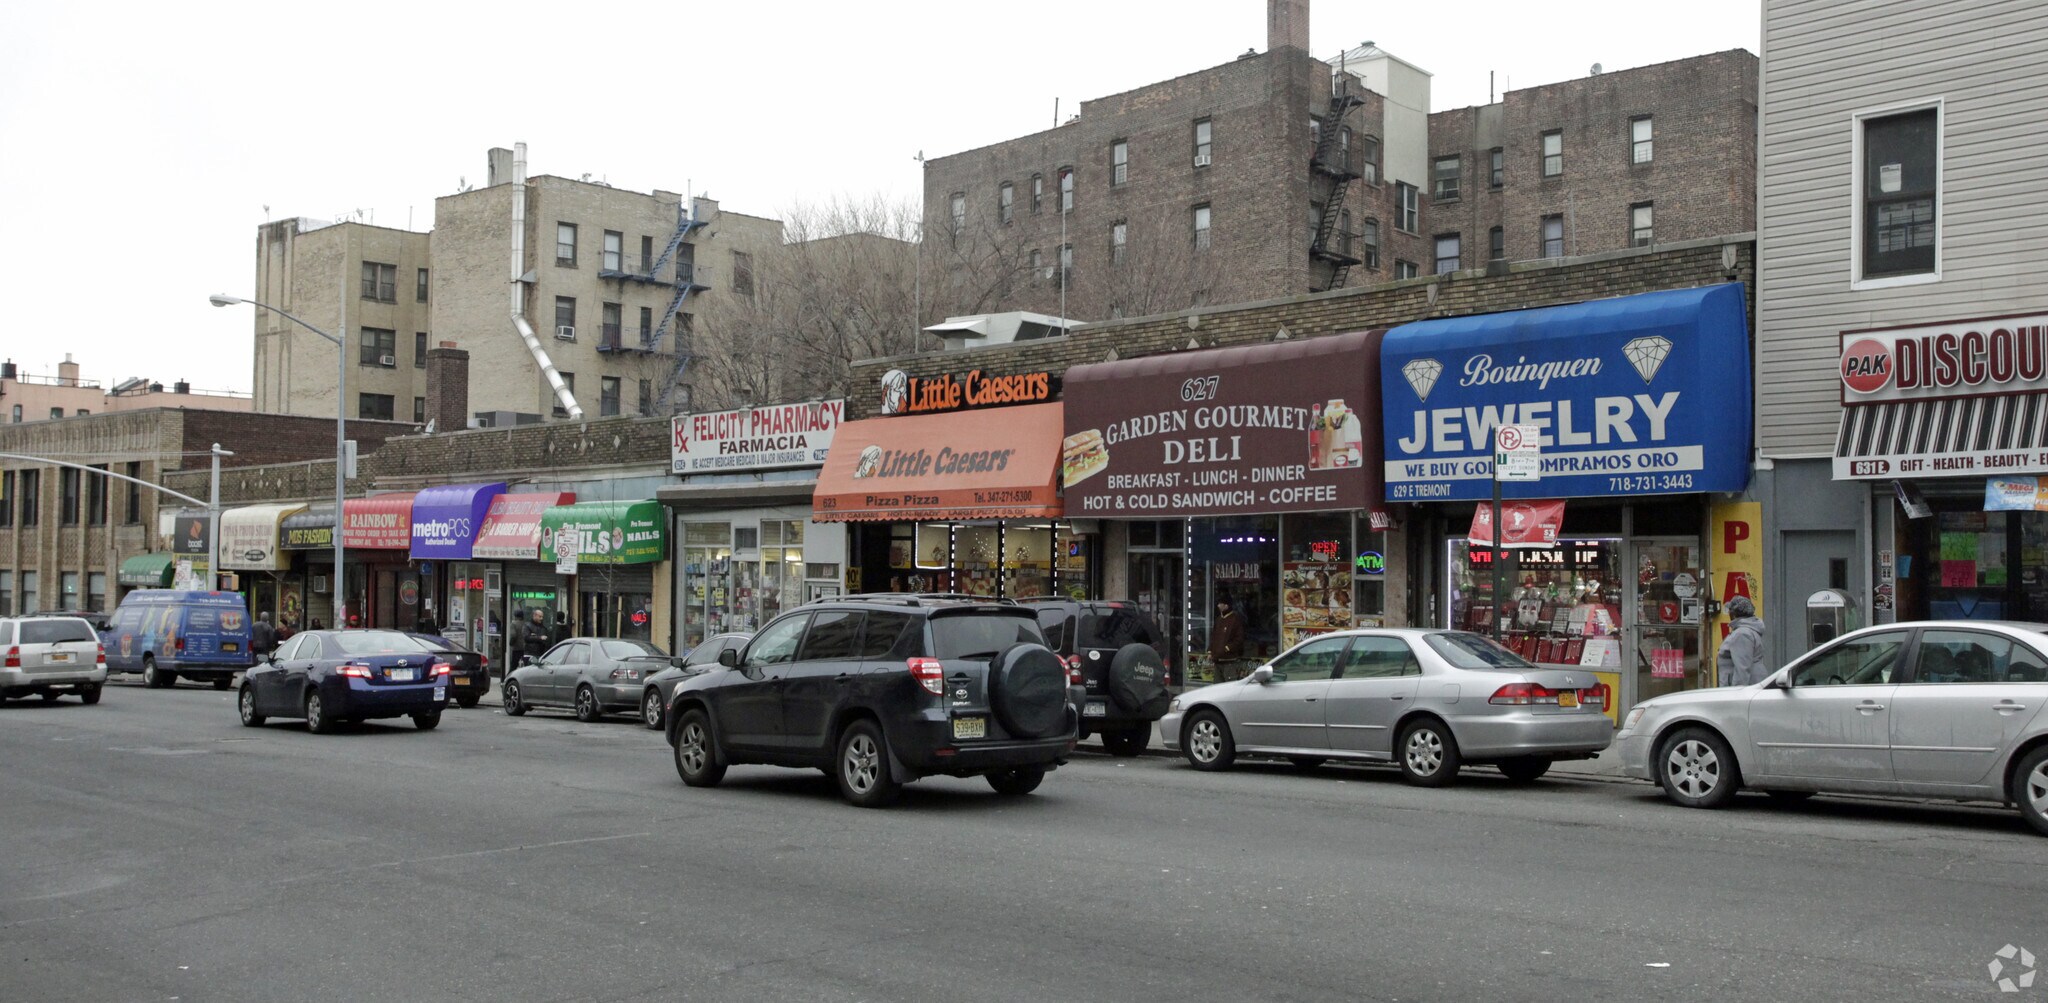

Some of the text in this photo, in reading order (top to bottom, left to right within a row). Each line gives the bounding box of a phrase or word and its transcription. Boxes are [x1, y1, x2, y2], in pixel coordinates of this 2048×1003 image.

[1846, 353, 1888, 377] PAK
[1894, 325, 2048, 390] DISCOU
[1459, 353, 1603, 390] Borinquen
[908, 369, 1049, 411] Little Caesars
[1181, 375, 1219, 401] 627
[694, 401, 843, 442] FELICITY PHARMACY
[1106, 405, 1308, 445] GARDEN GOURMET
[1398, 391, 1681, 454] JEWELRY
[719, 434, 808, 455] FARMACIA
[1163, 436, 1242, 464] DELI
[699, 456, 714, 468] ACCEPT
[715, 454, 735, 468] MEDICARE
[736, 453, 756, 467] MEDICAID
[761, 452, 776, 465] MAJOR
[776, 450, 805, 463] INSURANCES
[877, 447, 1010, 478] Little Caesars
[1405, 463, 1425, 477] WE
[1430, 462, 1458, 476] BUY
[1463, 461, 1493, 475] GOL
[1637, 452, 1679, 468] ORO
[1900, 459, 1924, 472] GIFT
[1933, 456, 1974, 470] HEALTH
[1984, 453, 2029, 468] BEAUTY
[2039, 452, 2048, 465] E
[1108, 472, 1181, 489] BREAKFAST
[1192, 469, 1238, 487] LUNCH
[1251, 464, 1305, 483] DINNER
[1393, 473, 1693, 498] 629 E TREMONT 718-731-3443
[822, 498, 837, 509] 623
[866, 495, 899, 506] Pizza
[903, 494, 939, 505] Pizza
[987, 490, 1032, 503] 347-271-5300
[1084, 495, 1112, 510] HOT
[1115, 495, 1125, 509] &
[1128, 493, 1168, 509] COLD
[1172, 490, 1254, 508] SANDWICH
[1269, 485, 1337, 504] COFFEE
[351, 513, 398, 528] RAINBOW
[413, 517, 470, 538] metroPCS
[575, 522, 602, 530] Tremont
[302, 528, 332, 544] FASHION
[626, 530, 660, 542] NAILS
[1311, 541, 1338, 553] OPEN
[1215, 562, 1260, 579] SALAD-BAR
[1357, 555, 1384, 569] ATM
[1134, 661, 1154, 677] Jeep
[1651, 658, 1683, 674] SALE
